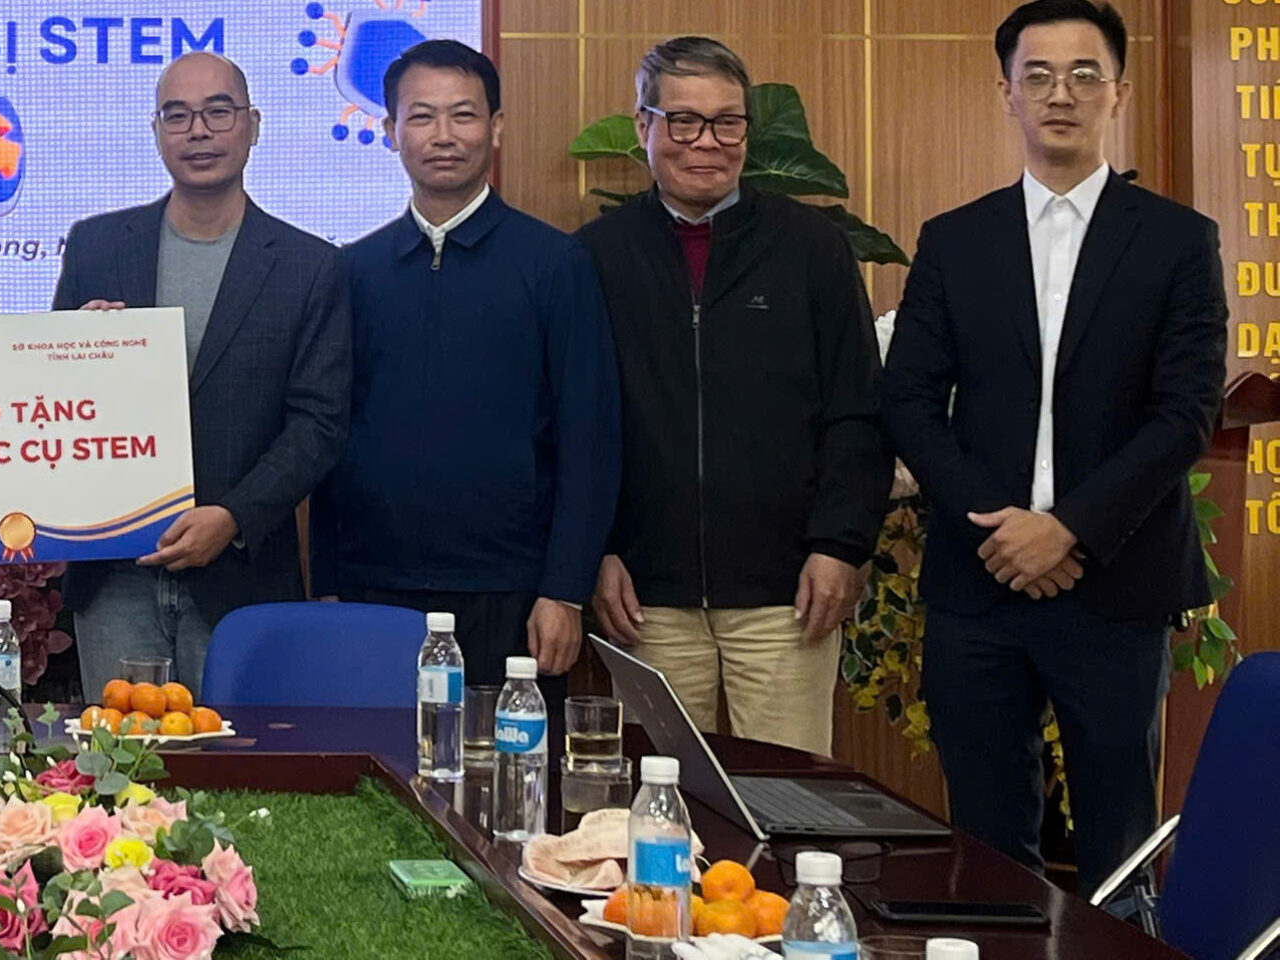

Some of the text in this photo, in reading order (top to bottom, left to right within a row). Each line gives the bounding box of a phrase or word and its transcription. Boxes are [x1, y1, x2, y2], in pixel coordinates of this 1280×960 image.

[39, 16, 225, 65] STEM
[10, 395, 97, 429] TẶNG
[20, 439, 62, 470] CỤ
[72, 435, 157, 460] STEM
